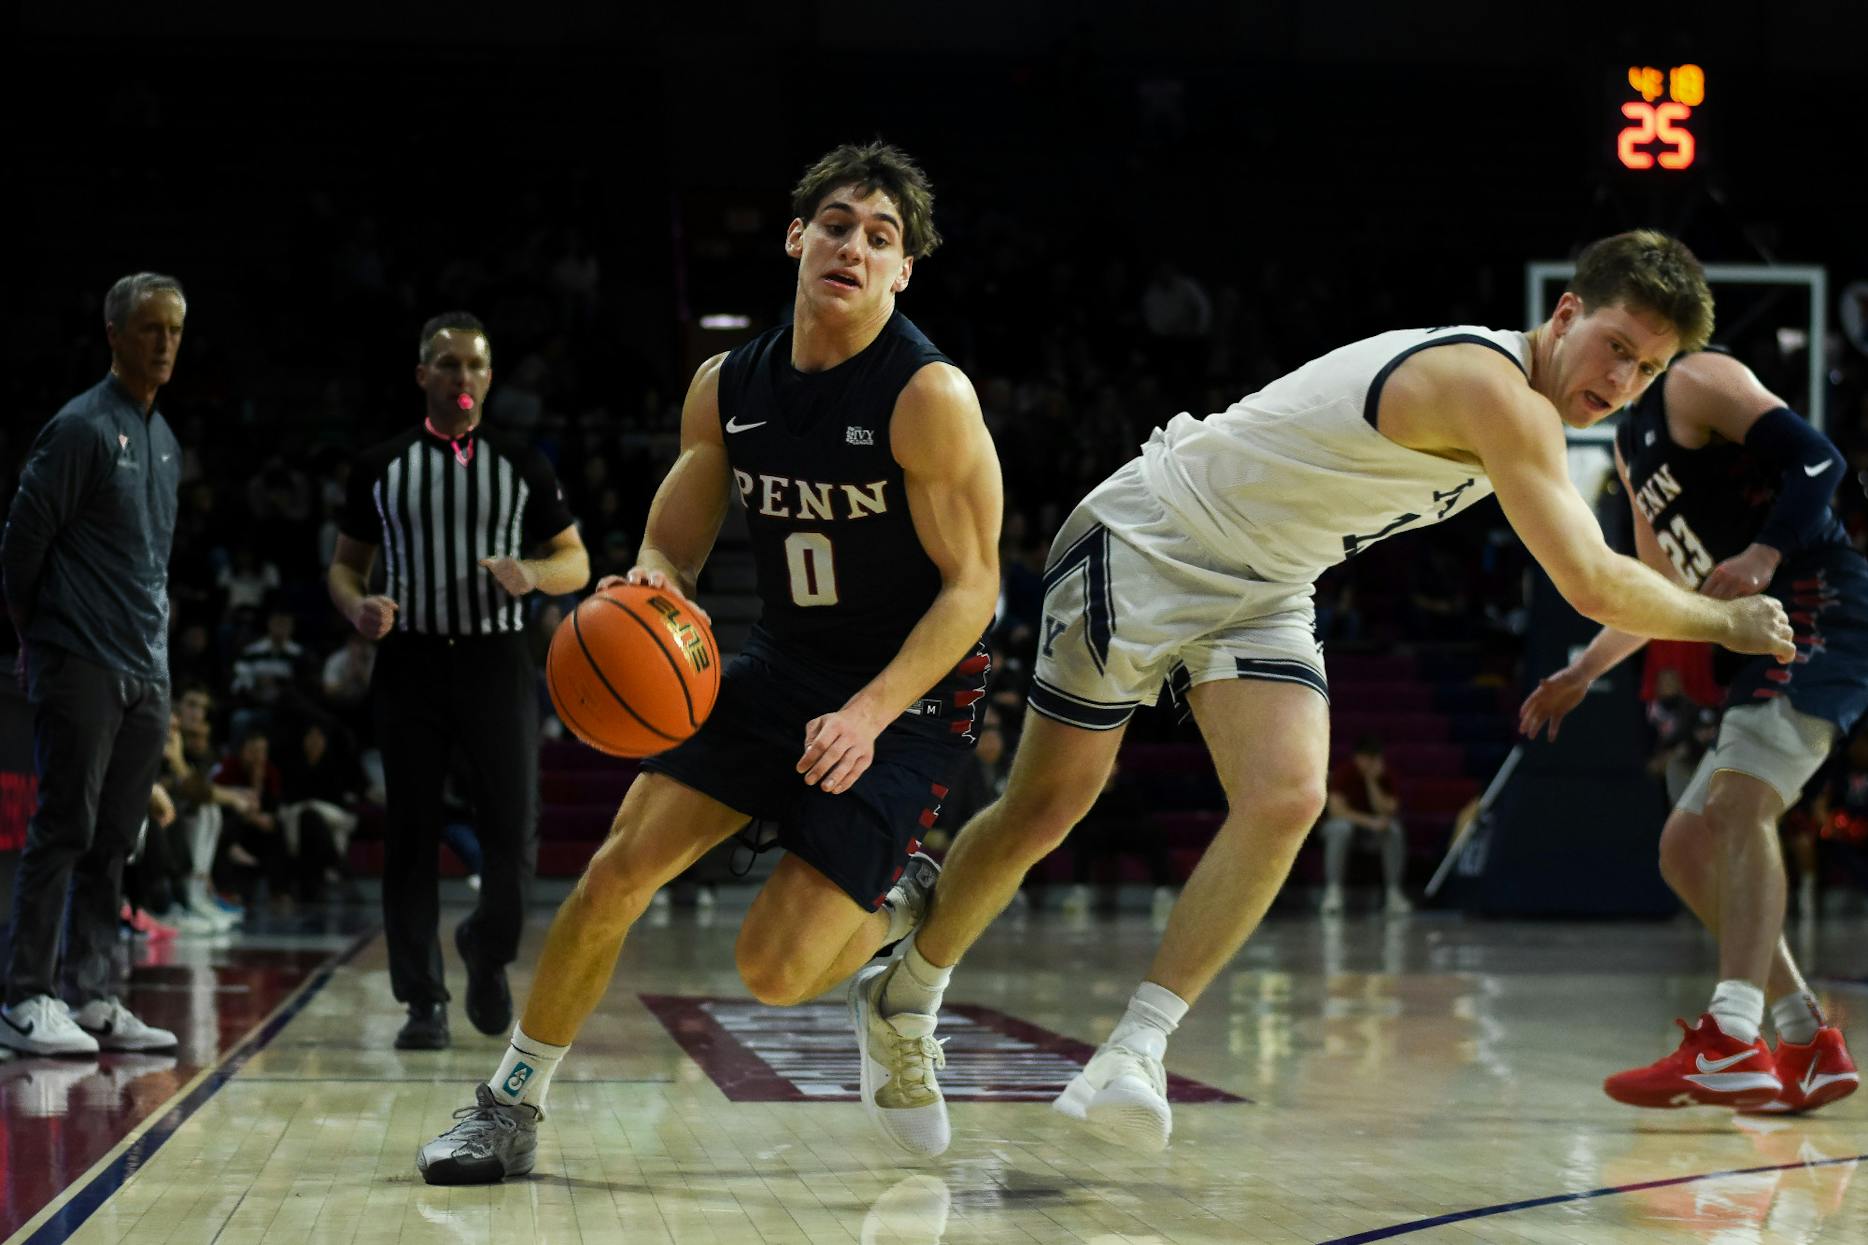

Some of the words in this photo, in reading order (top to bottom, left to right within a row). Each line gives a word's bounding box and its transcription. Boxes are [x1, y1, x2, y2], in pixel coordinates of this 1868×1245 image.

[1617, 101, 1696, 170] 25
[733, 466, 889, 521] PENN
[1635, 462, 1683, 524] ENN
[784, 530, 839, 608] 0
[1656, 513, 1714, 589] 23
[1043, 614, 1068, 657] Y
